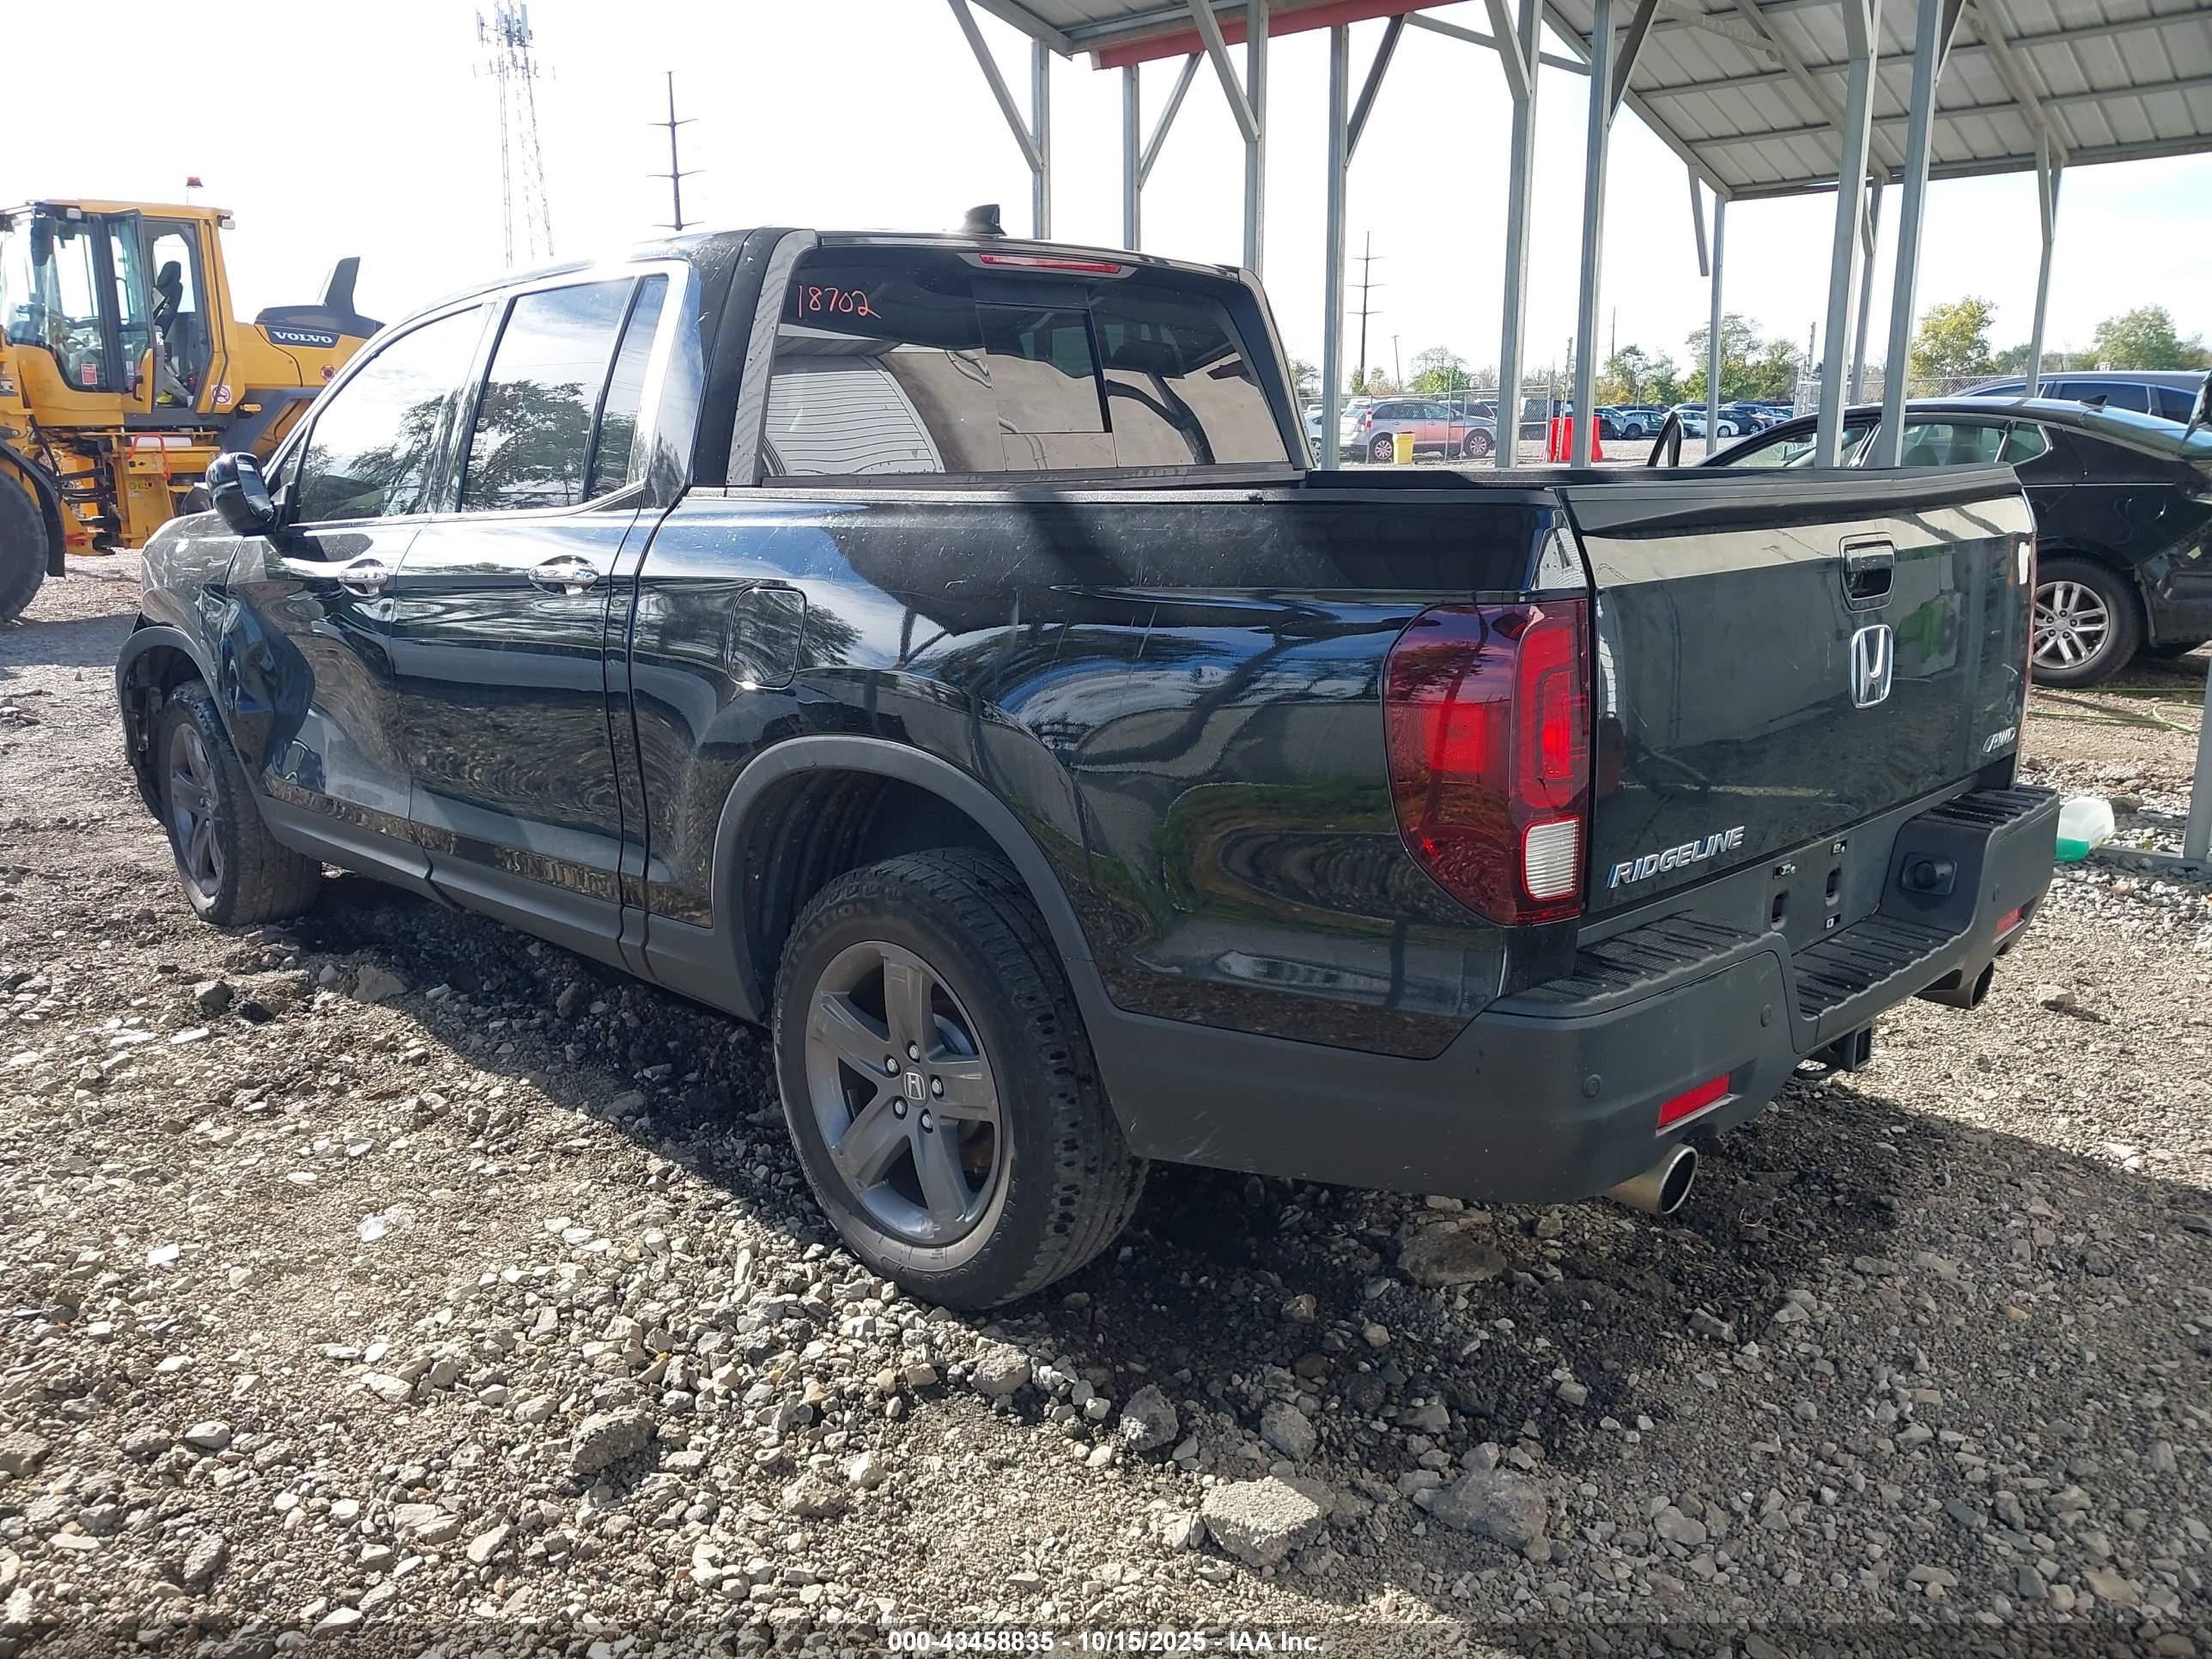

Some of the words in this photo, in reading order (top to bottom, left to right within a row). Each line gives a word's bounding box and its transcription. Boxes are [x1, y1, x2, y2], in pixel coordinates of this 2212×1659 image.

[799, 285, 882, 319] 18702
[272, 331, 333, 343] VOLVO
[1982, 726, 2017, 753] AWD
[1607, 825, 1746, 890] RIDGELINE
